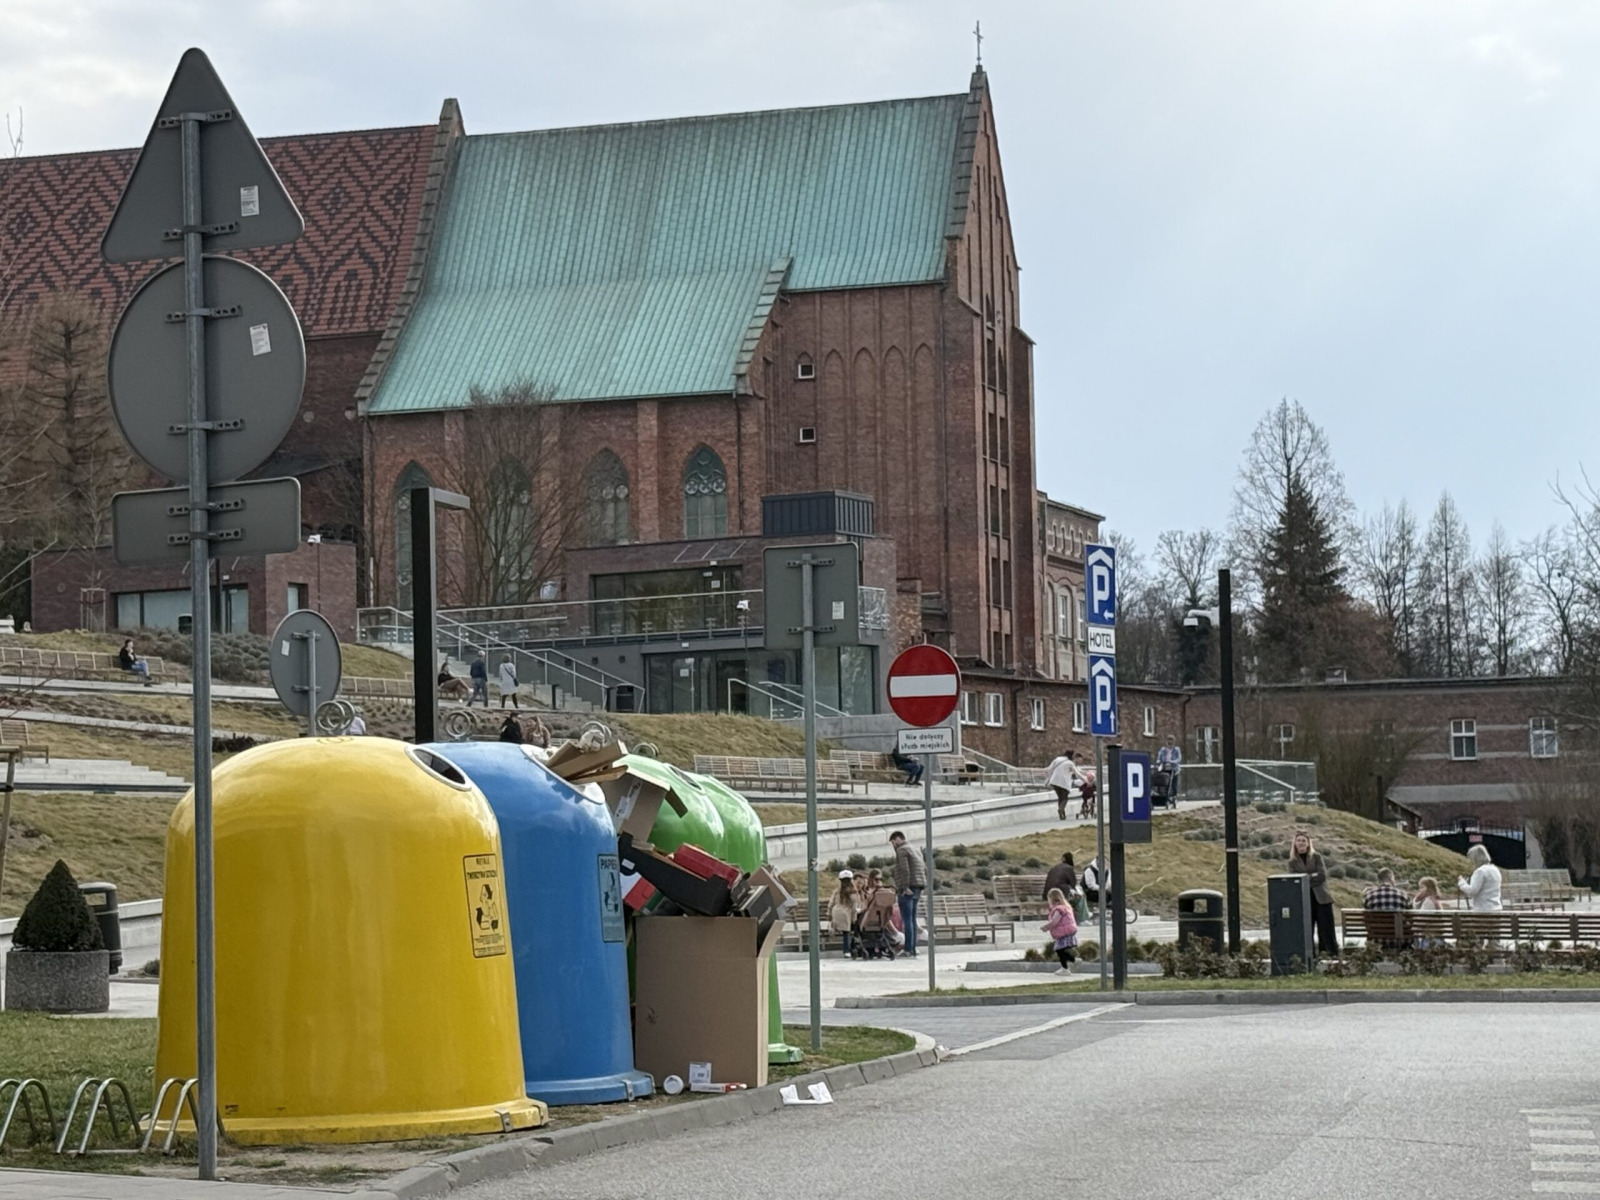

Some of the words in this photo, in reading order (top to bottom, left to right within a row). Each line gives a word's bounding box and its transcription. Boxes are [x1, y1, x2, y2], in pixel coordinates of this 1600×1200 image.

[1092, 564, 1110, 614] P
[1089, 631, 1114, 649] HOTEL
[1095, 674, 1112, 725] P
[1126, 762, 1144, 813] P
